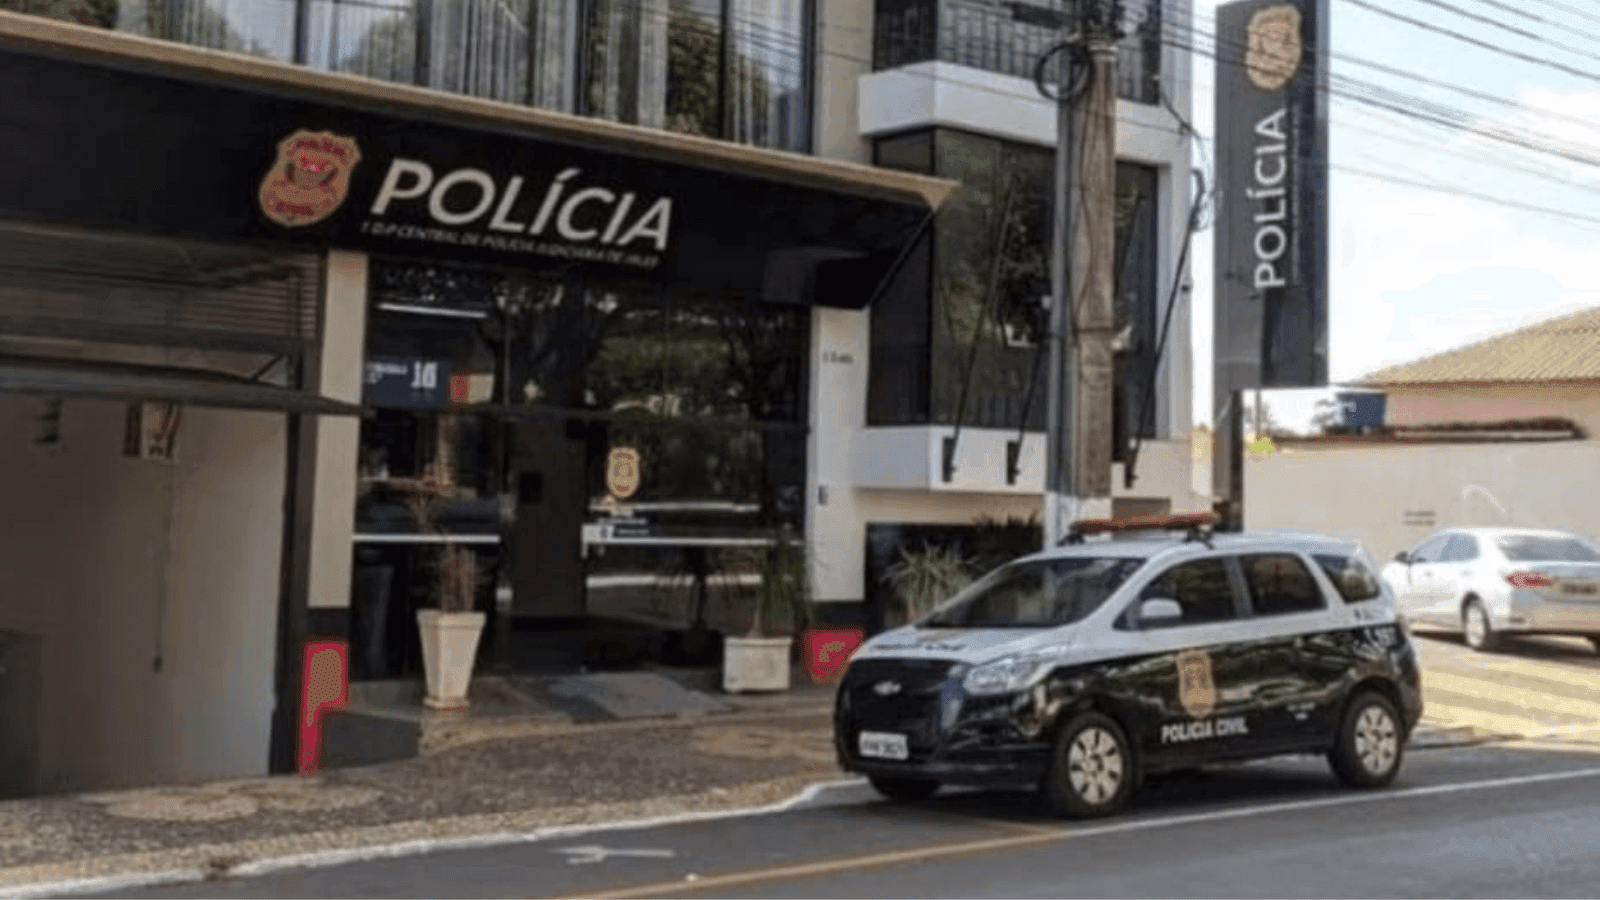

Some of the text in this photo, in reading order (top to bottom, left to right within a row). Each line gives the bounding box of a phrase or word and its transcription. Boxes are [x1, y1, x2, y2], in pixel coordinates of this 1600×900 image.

[371, 158, 673, 251] POLÍCIA
[1246, 108, 1287, 289] POLÍCIA
[1216, 717, 1249, 737] CIVIL
